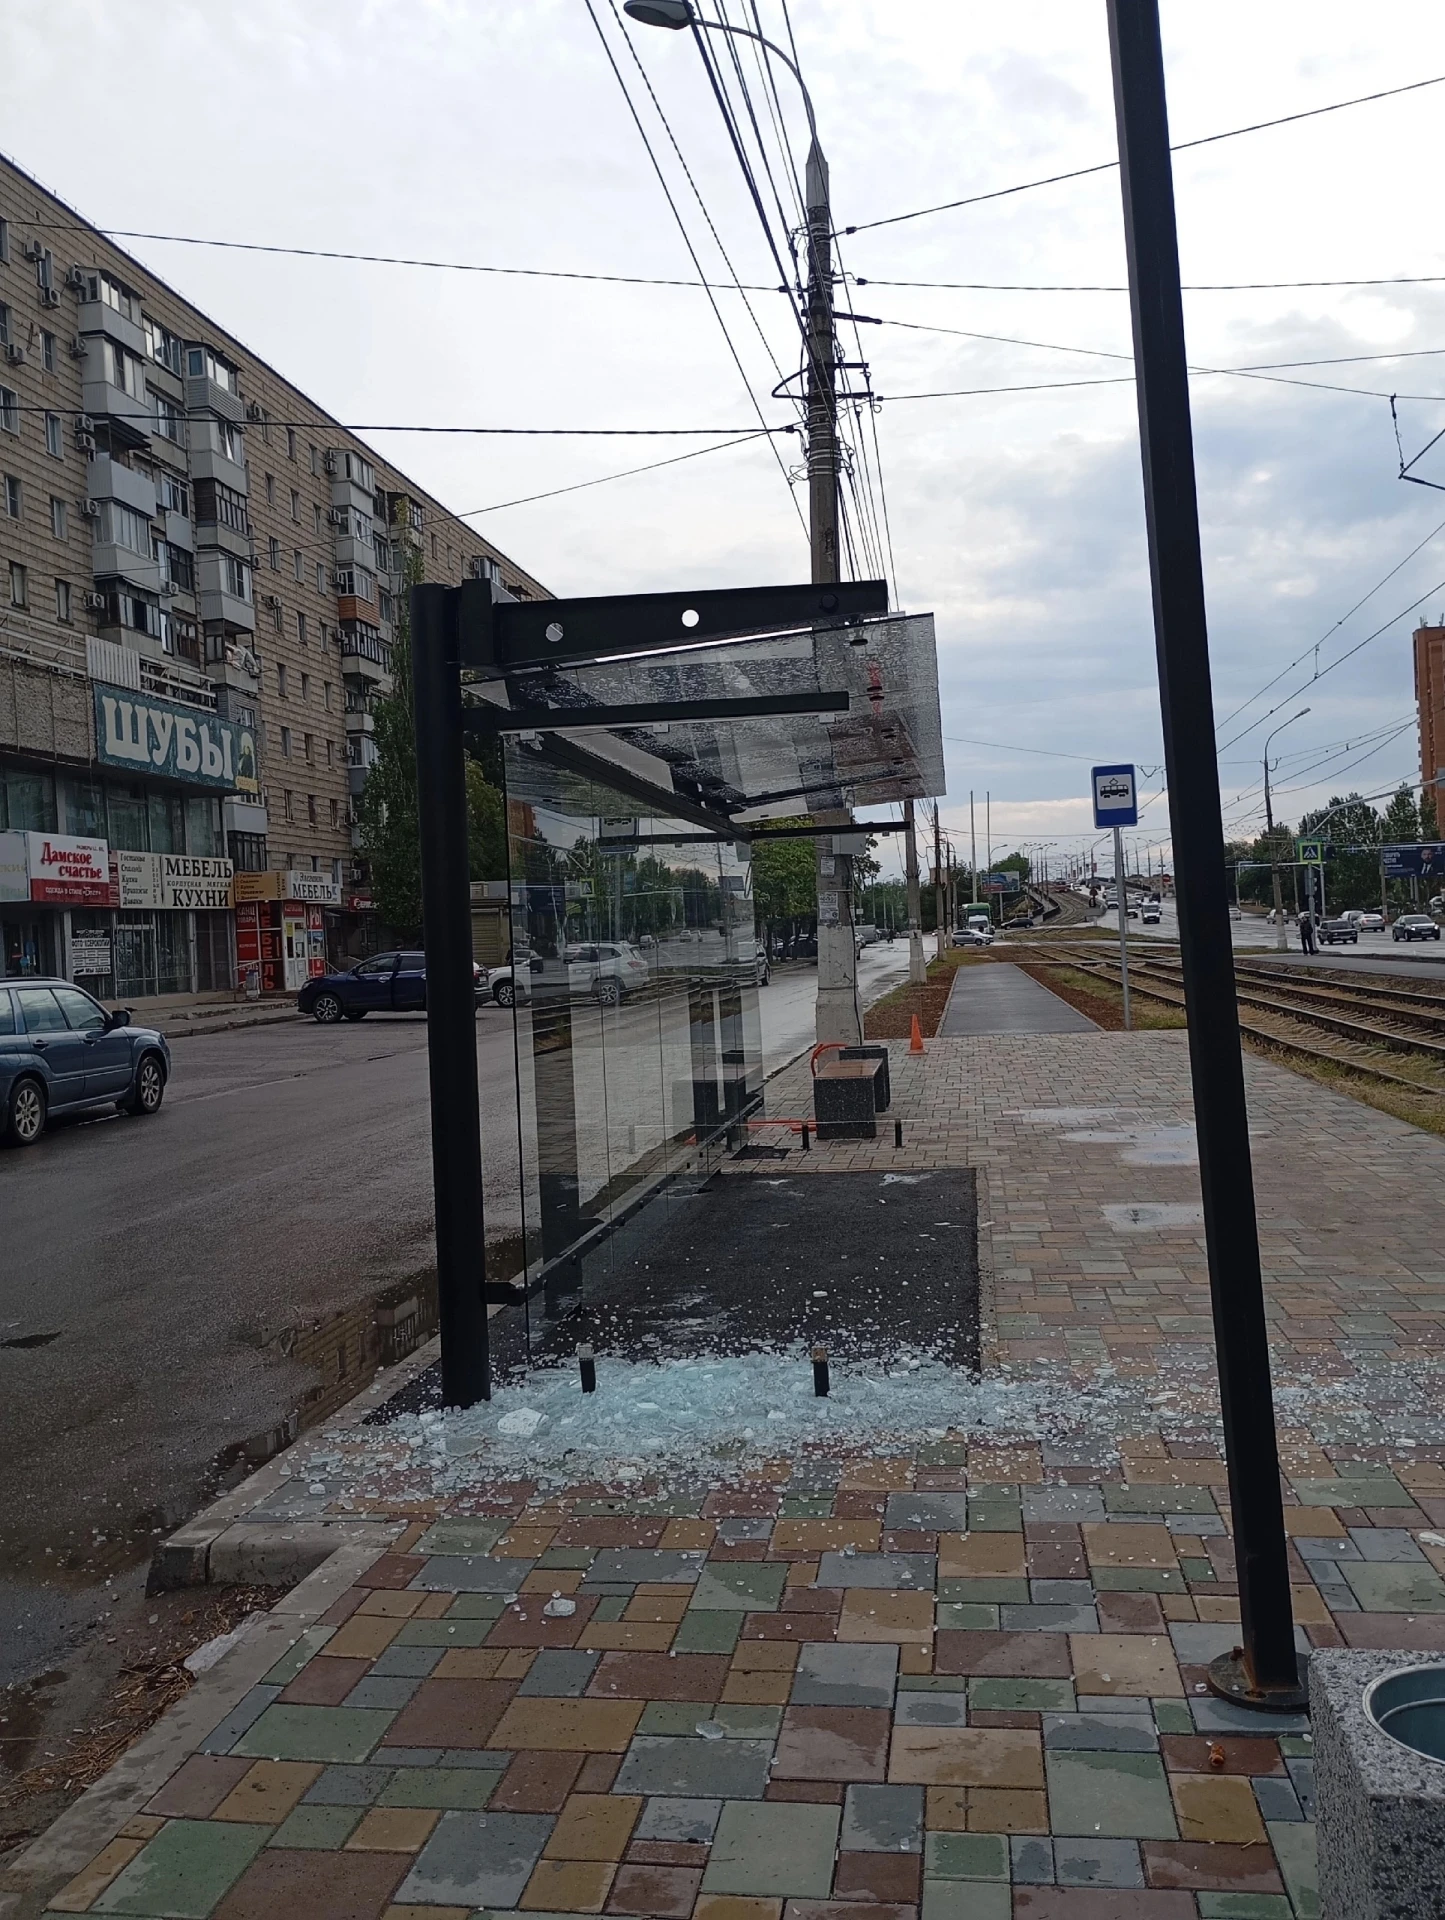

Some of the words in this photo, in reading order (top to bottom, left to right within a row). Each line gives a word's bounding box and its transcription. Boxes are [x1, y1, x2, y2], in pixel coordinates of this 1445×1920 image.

[101, 695, 234, 781] ШУБЫ
[41, 841, 92, 866] Дамское
[58, 864, 103, 879] счастье
[164, 857, 232, 879] МЕБЕЛЬ
[166, 881, 202, 889] КОРПУСНАЯ
[206, 881, 232, 889] МЯГКАЯ
[292, 883, 332, 900] МЕБЕЛЬ
[172, 889, 230, 908] КУХНИ
[237, 905, 256, 916] КАНЦ
[261, 903, 275, 989] МЕБЕЛЬ
